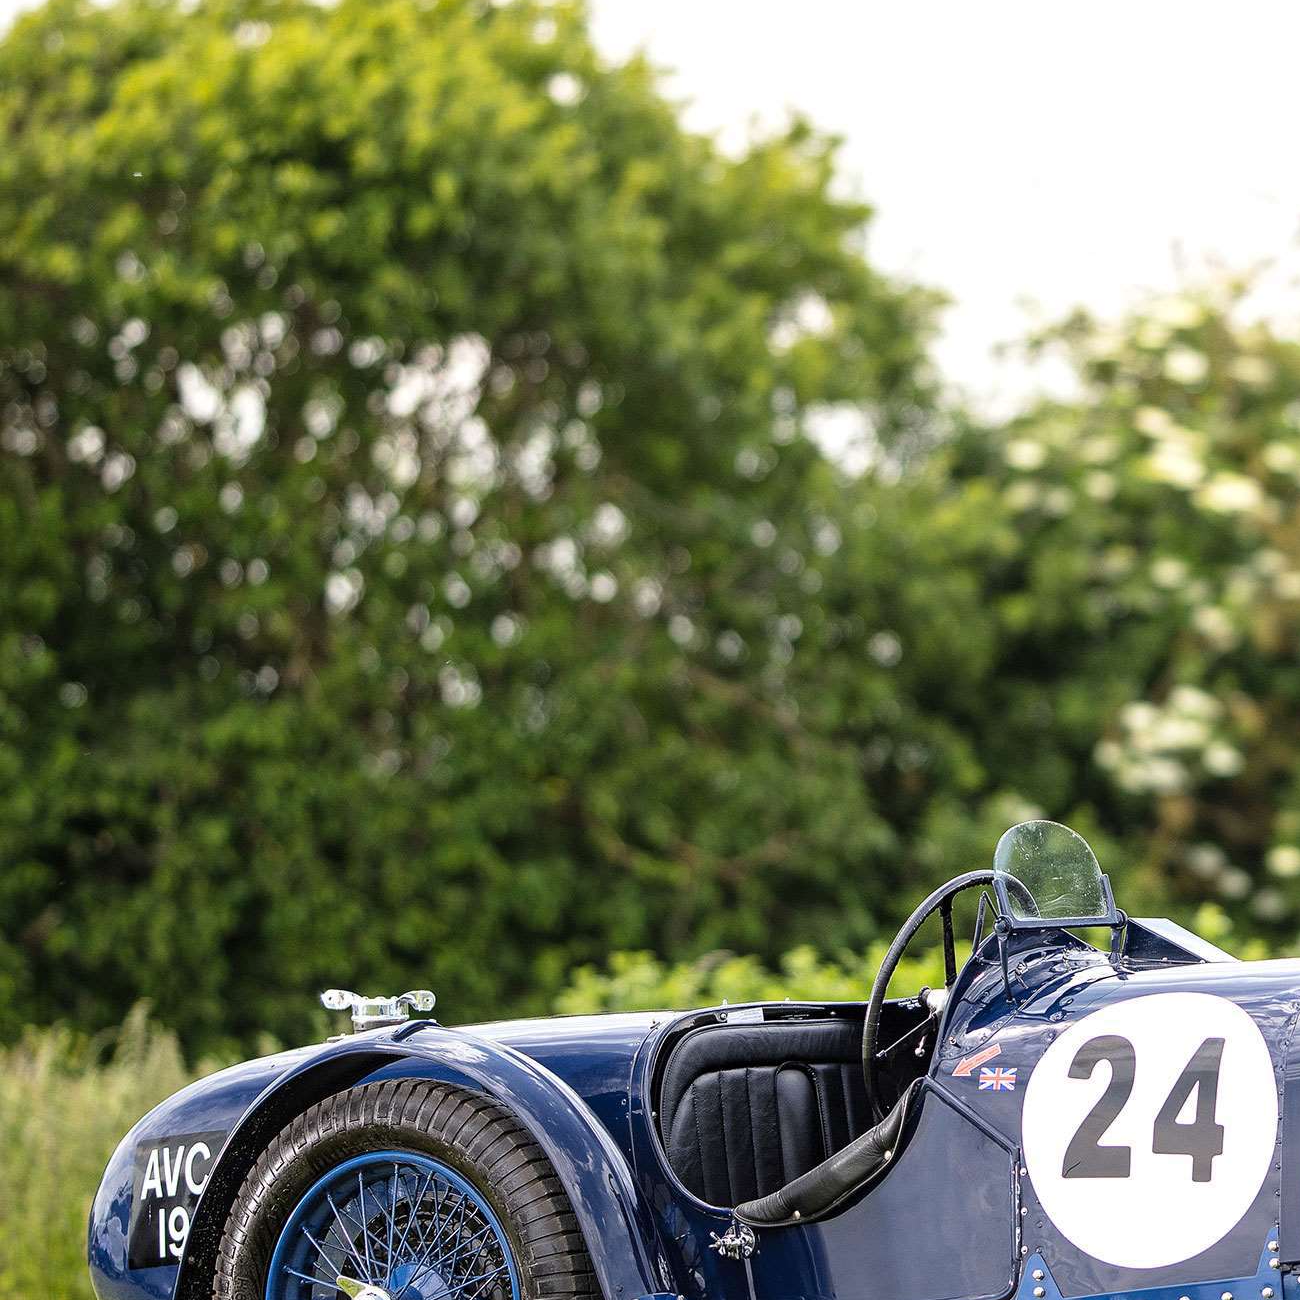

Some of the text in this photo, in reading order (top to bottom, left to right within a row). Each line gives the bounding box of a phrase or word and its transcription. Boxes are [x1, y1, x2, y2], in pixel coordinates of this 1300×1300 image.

[1061, 1033, 1225, 1183] 24
[141, 1141, 211, 1200] AVC
[158, 1205, 190, 1259] 19
